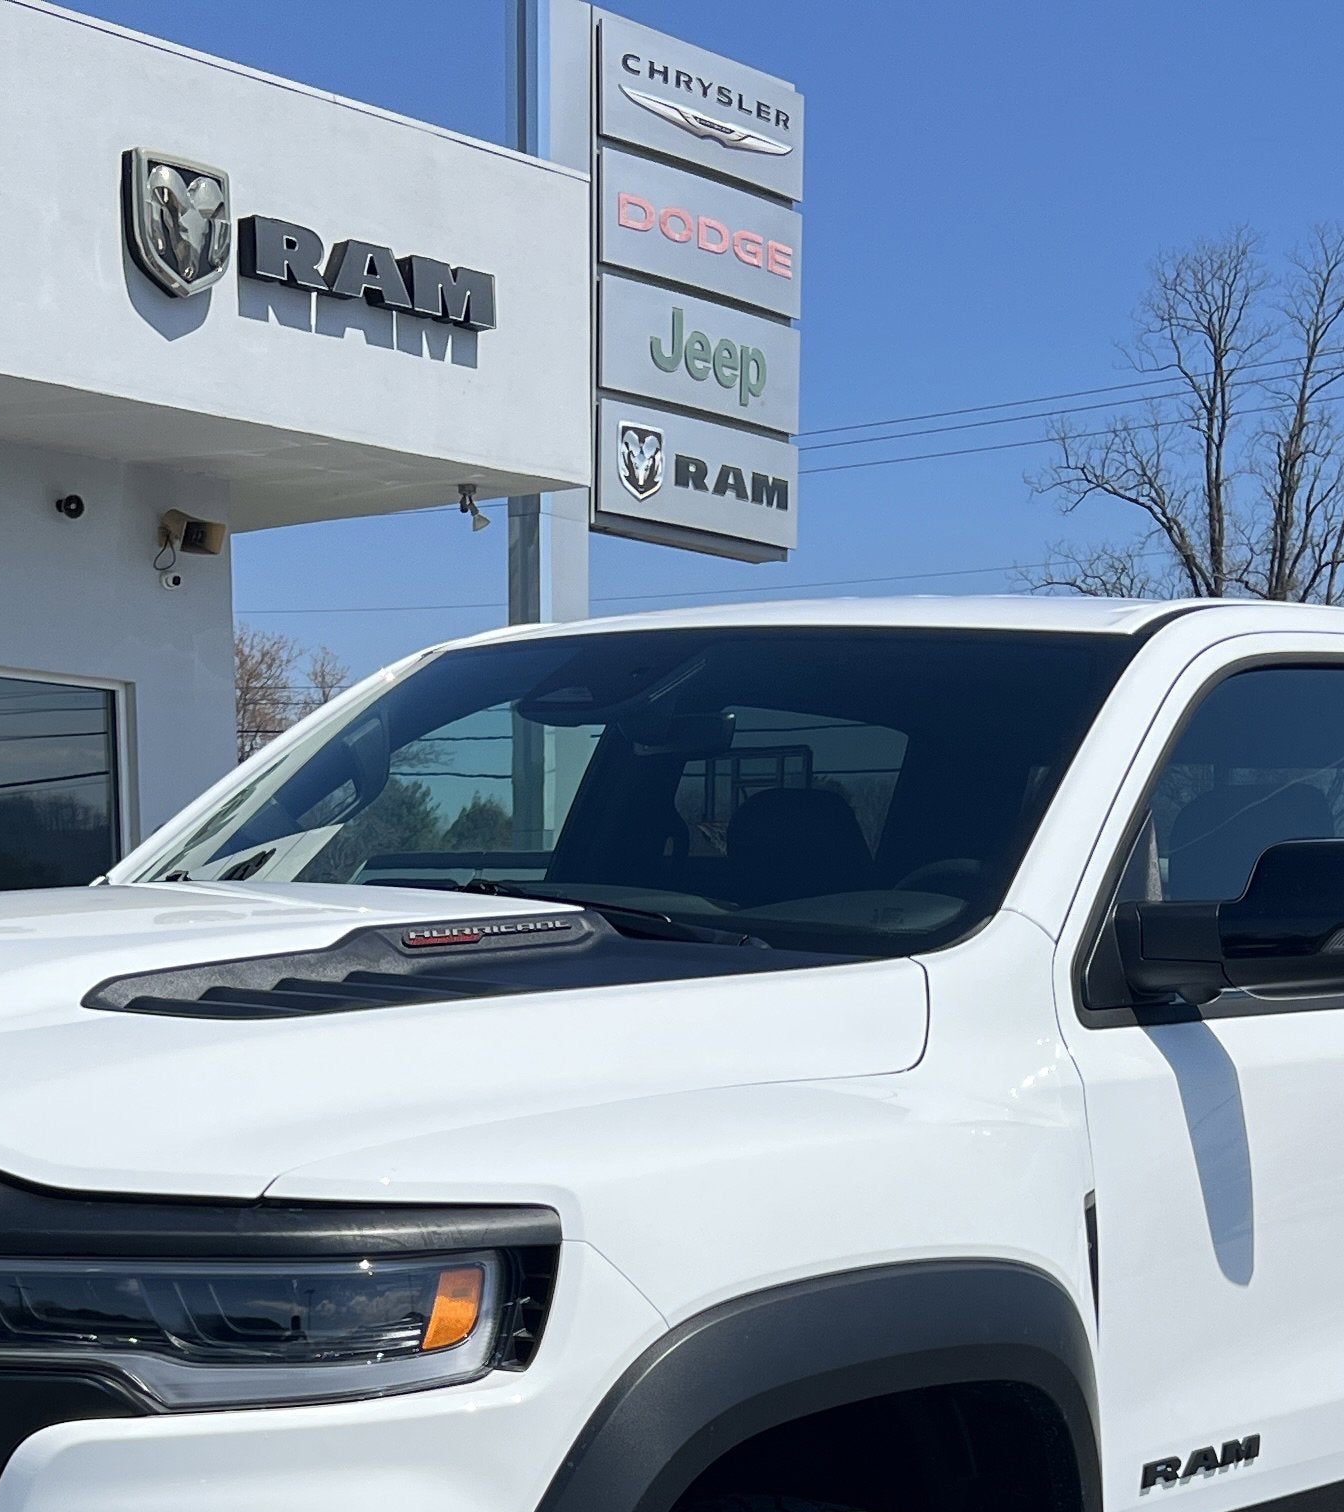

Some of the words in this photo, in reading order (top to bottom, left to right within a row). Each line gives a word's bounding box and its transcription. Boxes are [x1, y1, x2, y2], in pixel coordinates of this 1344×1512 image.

[621, 53, 791, 131] CHRYSLER
[238, 215, 497, 332] RAM
[617, 191, 794, 281] DODGE
[649, 306, 768, 408] Jeep
[673, 453, 790, 512] RAM
[408, 919, 572, 939] HURRICANE
[1140, 1433, 1261, 1490] RAM
